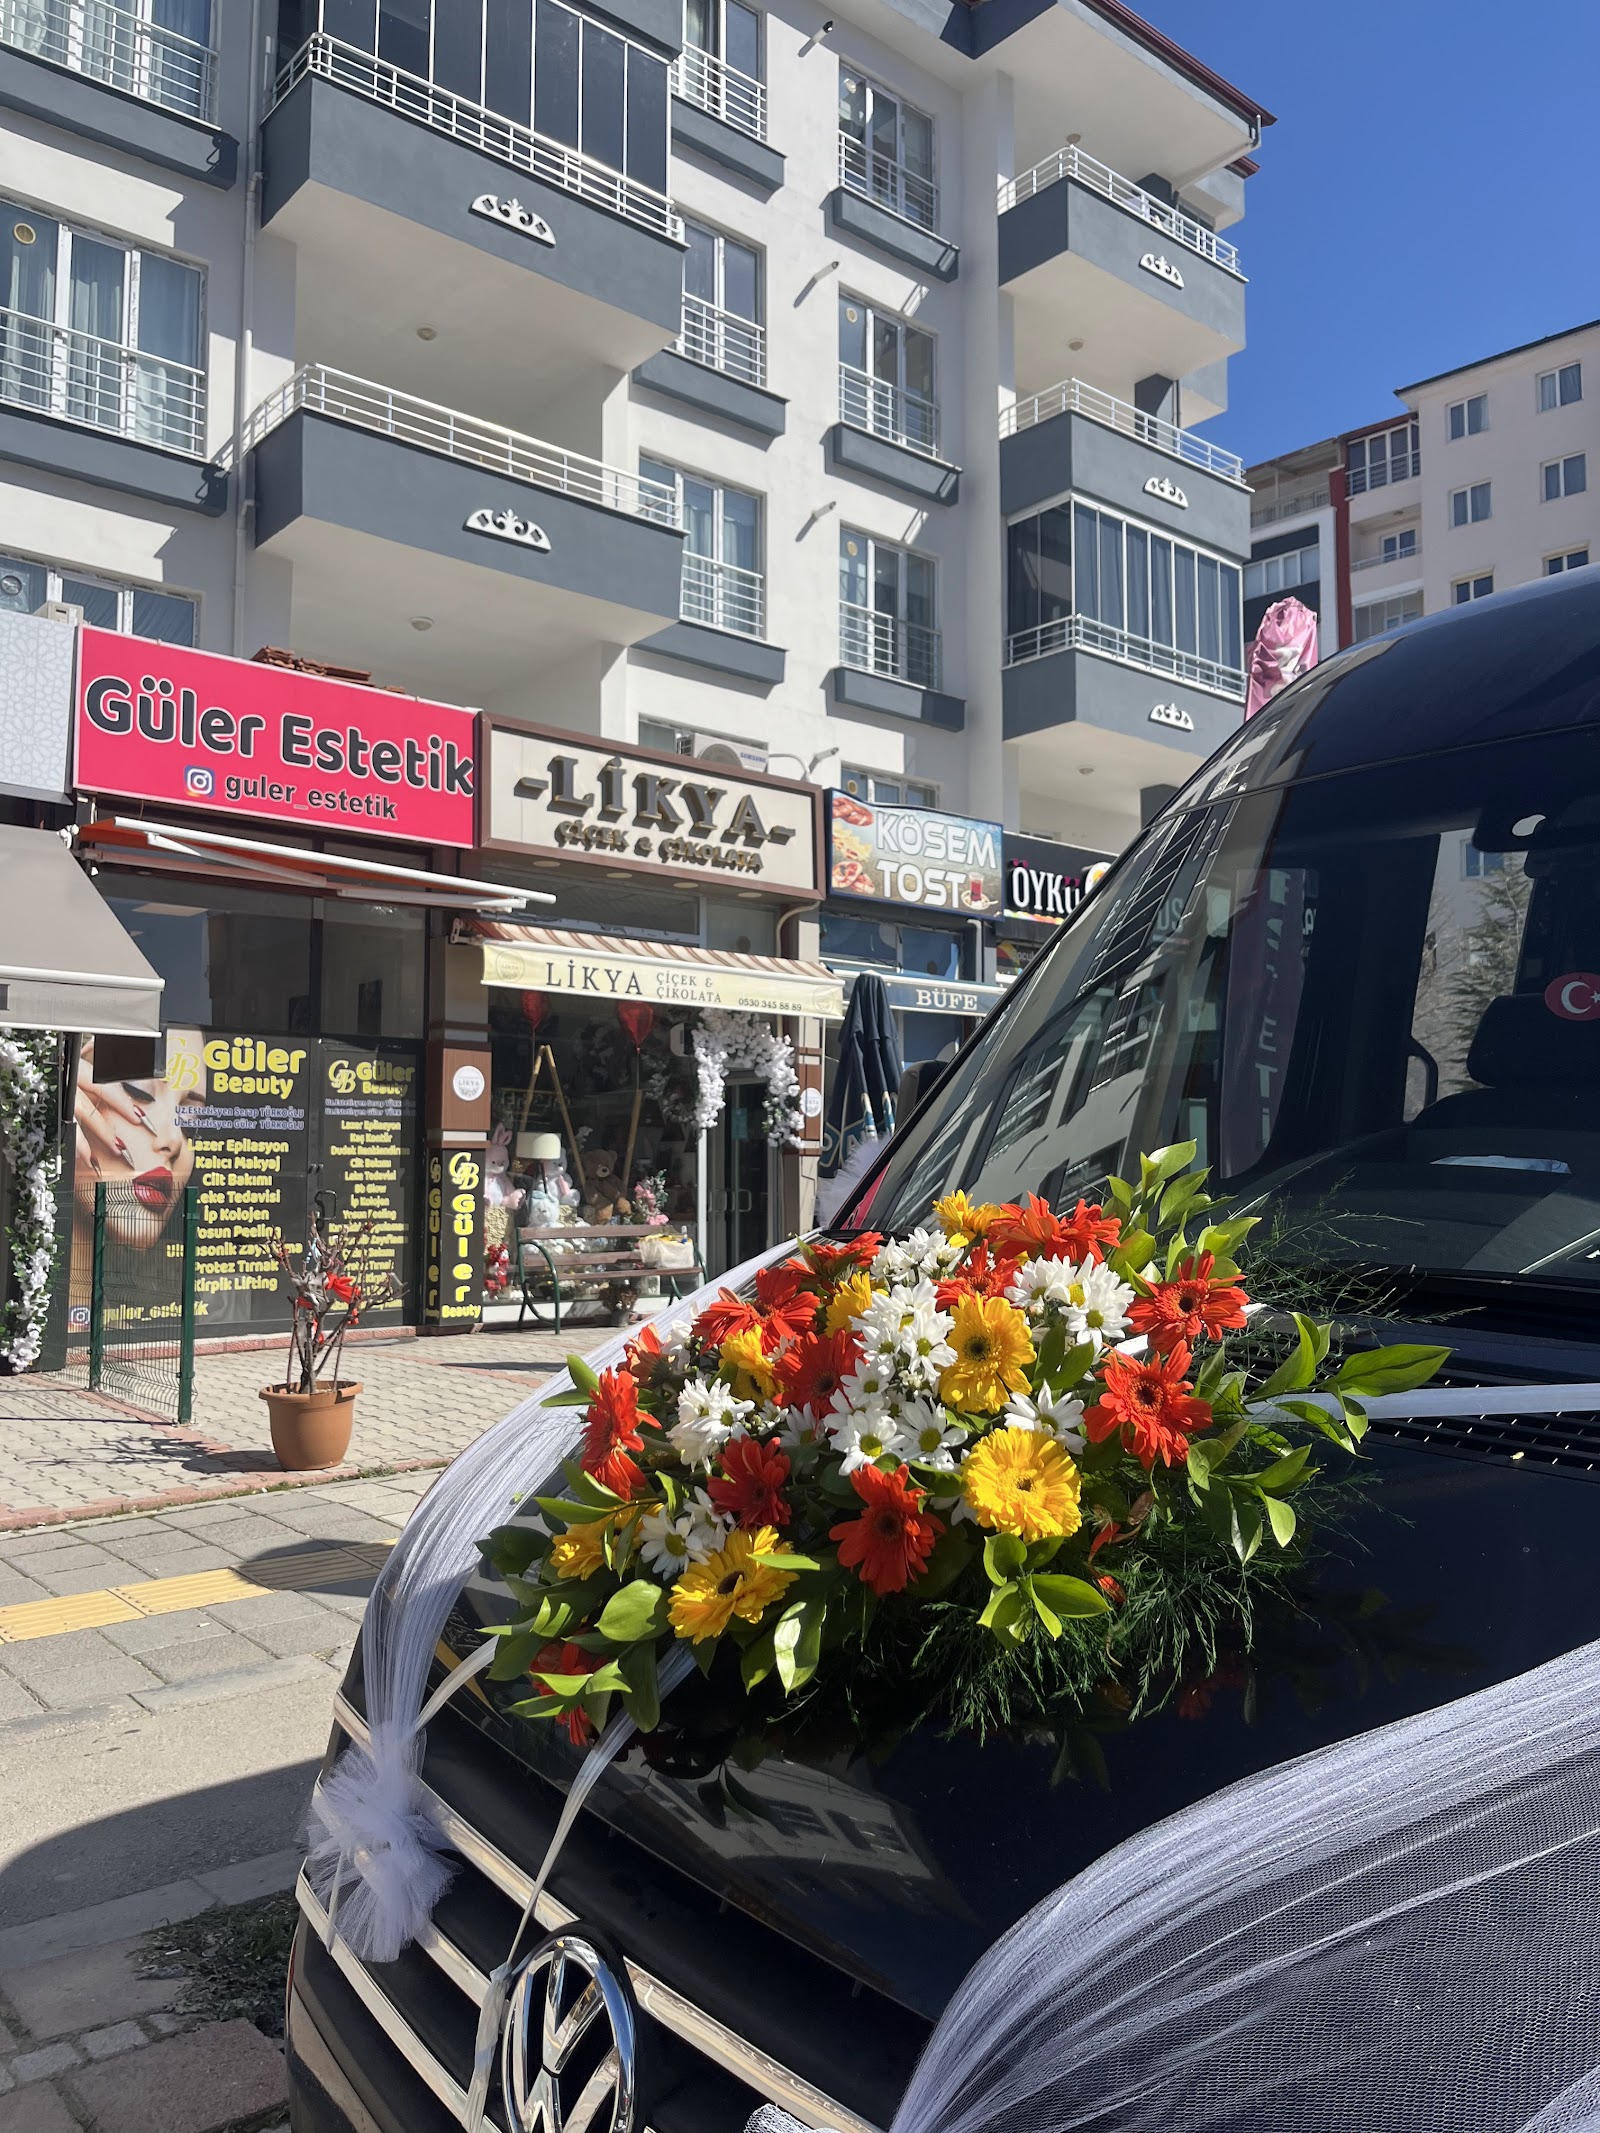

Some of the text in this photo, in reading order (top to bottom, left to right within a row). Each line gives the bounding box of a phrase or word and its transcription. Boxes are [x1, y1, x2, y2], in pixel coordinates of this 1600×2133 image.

[85, 674, 475, 796] Güler Estetik
[225, 774, 398, 820] guler_estetik
[554, 819, 764, 874] ÇİÇEK & ÇİKOLATA
[874, 810, 998, 870] KÖSEM
[875, 859, 969, 909] TOST
[546, 959, 714, 995] LİKYA ÇİÇEK &
[656, 986, 802, 1013] ÇİKOLATA 0530 345 88 89
[916, 987, 978, 1011] BÜFE
[203, 1036, 307, 1075] Güler
[356, 1060, 416, 1082] Güler
[213, 1072, 294, 1099] Beauty
[362, 1080, 409, 1097] Beauty
[233, 1106, 259, 1118] Serap
[260, 1105, 305, 1119] TÜRKOĞLU
[233, 1118, 258, 1129] Güler
[260, 1117, 305, 1131] TÜRKOĞLU
[187, 1138, 290, 1155] Lazer Epilasyon
[195, 1155, 282, 1172] Kalıcı Makyaj
[202, 1171, 273, 1187] Cilt Bakımı
[226, 1189, 281, 1204] Tedavisi
[204, 1204, 270, 1224] İp Kolojen
[233, 1223, 282, 1239] Peeling
[451, 1193, 476, 1303] Güler
[237, 1259, 280, 1272] Tırnak
[234, 1275, 279, 1291] Lifting
[442, 1303, 482, 1319] Beauty
